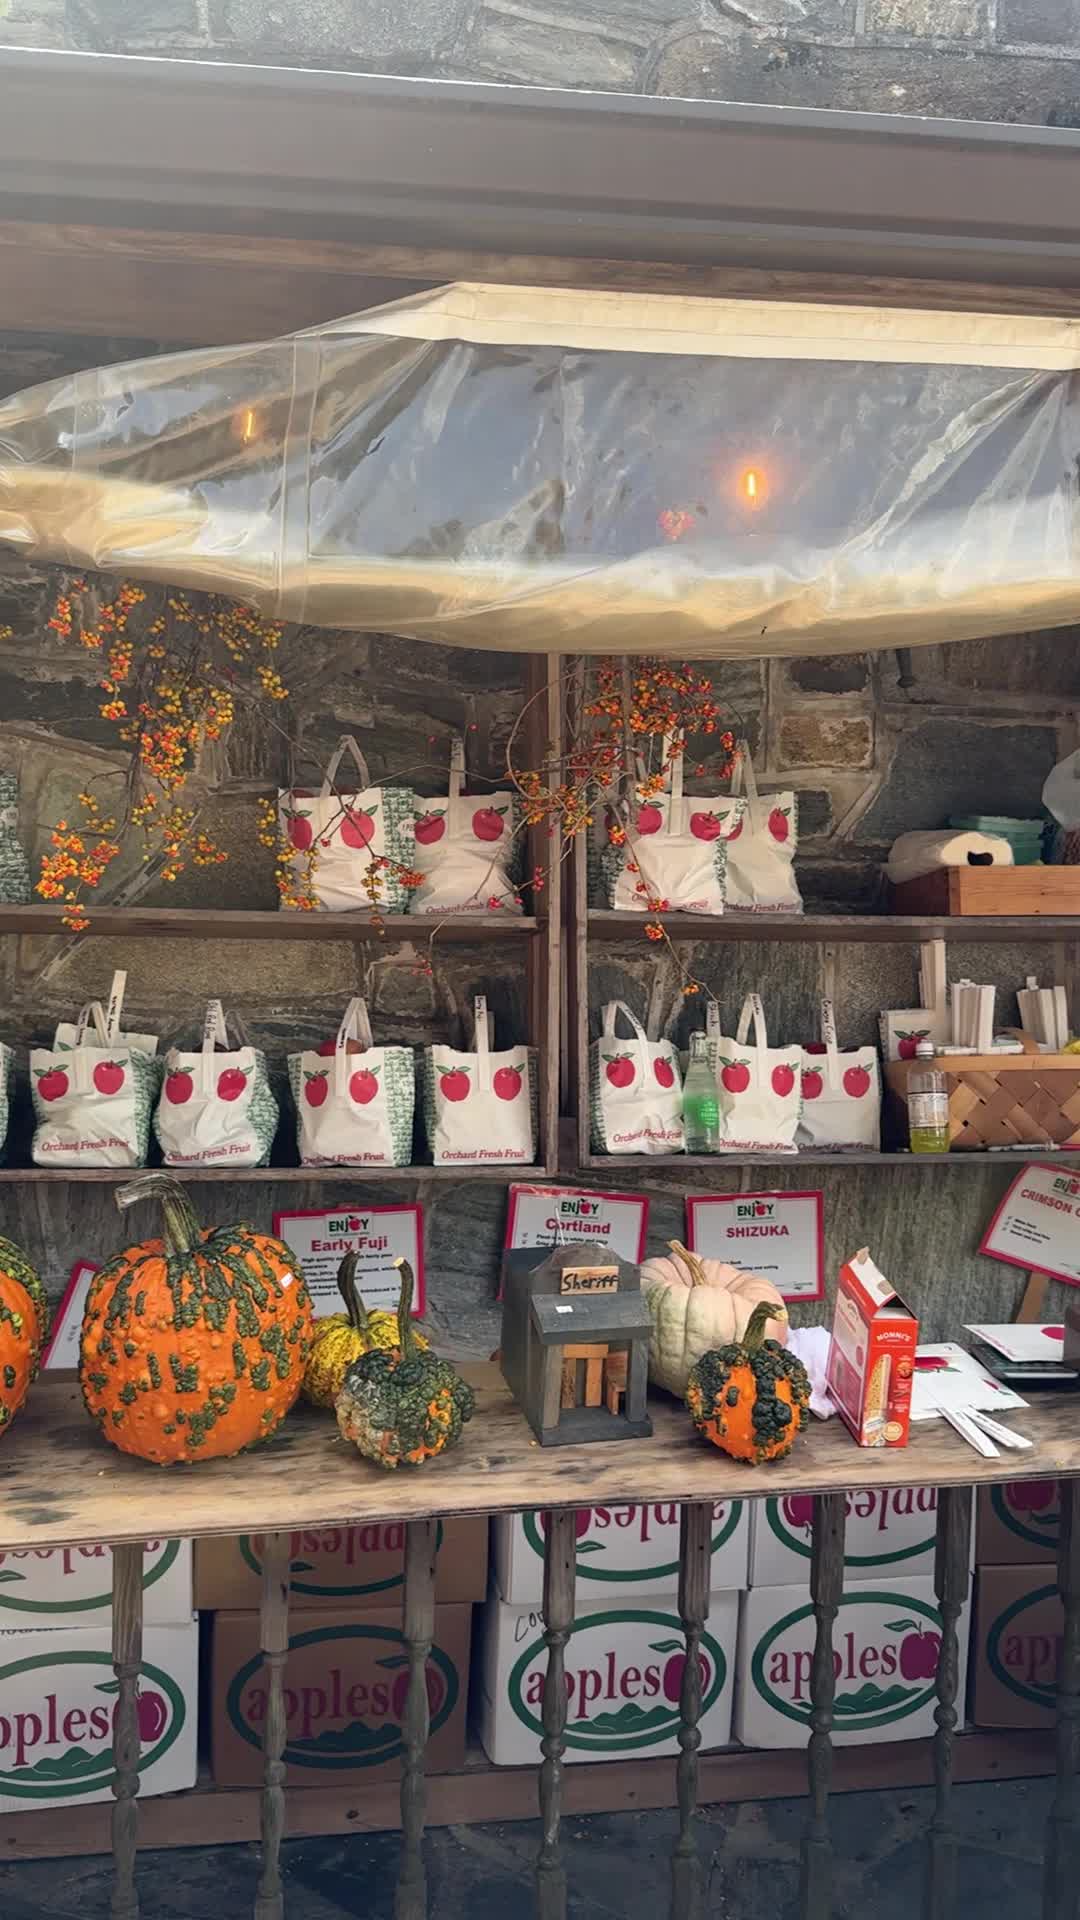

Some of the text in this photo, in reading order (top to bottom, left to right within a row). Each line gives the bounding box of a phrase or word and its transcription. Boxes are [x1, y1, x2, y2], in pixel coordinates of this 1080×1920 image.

[442, 1148, 525, 1159] Orchard Fresh Fruit
[1021, 1188, 1073, 1214] CRIMSON
[546, 1218, 611, 1234] Cortland
[726, 1225, 790, 1238] SHIZUKA
[311, 1236, 388, 1254] Early Fuji
[561, 1272, 619, 1291] Sheriff
